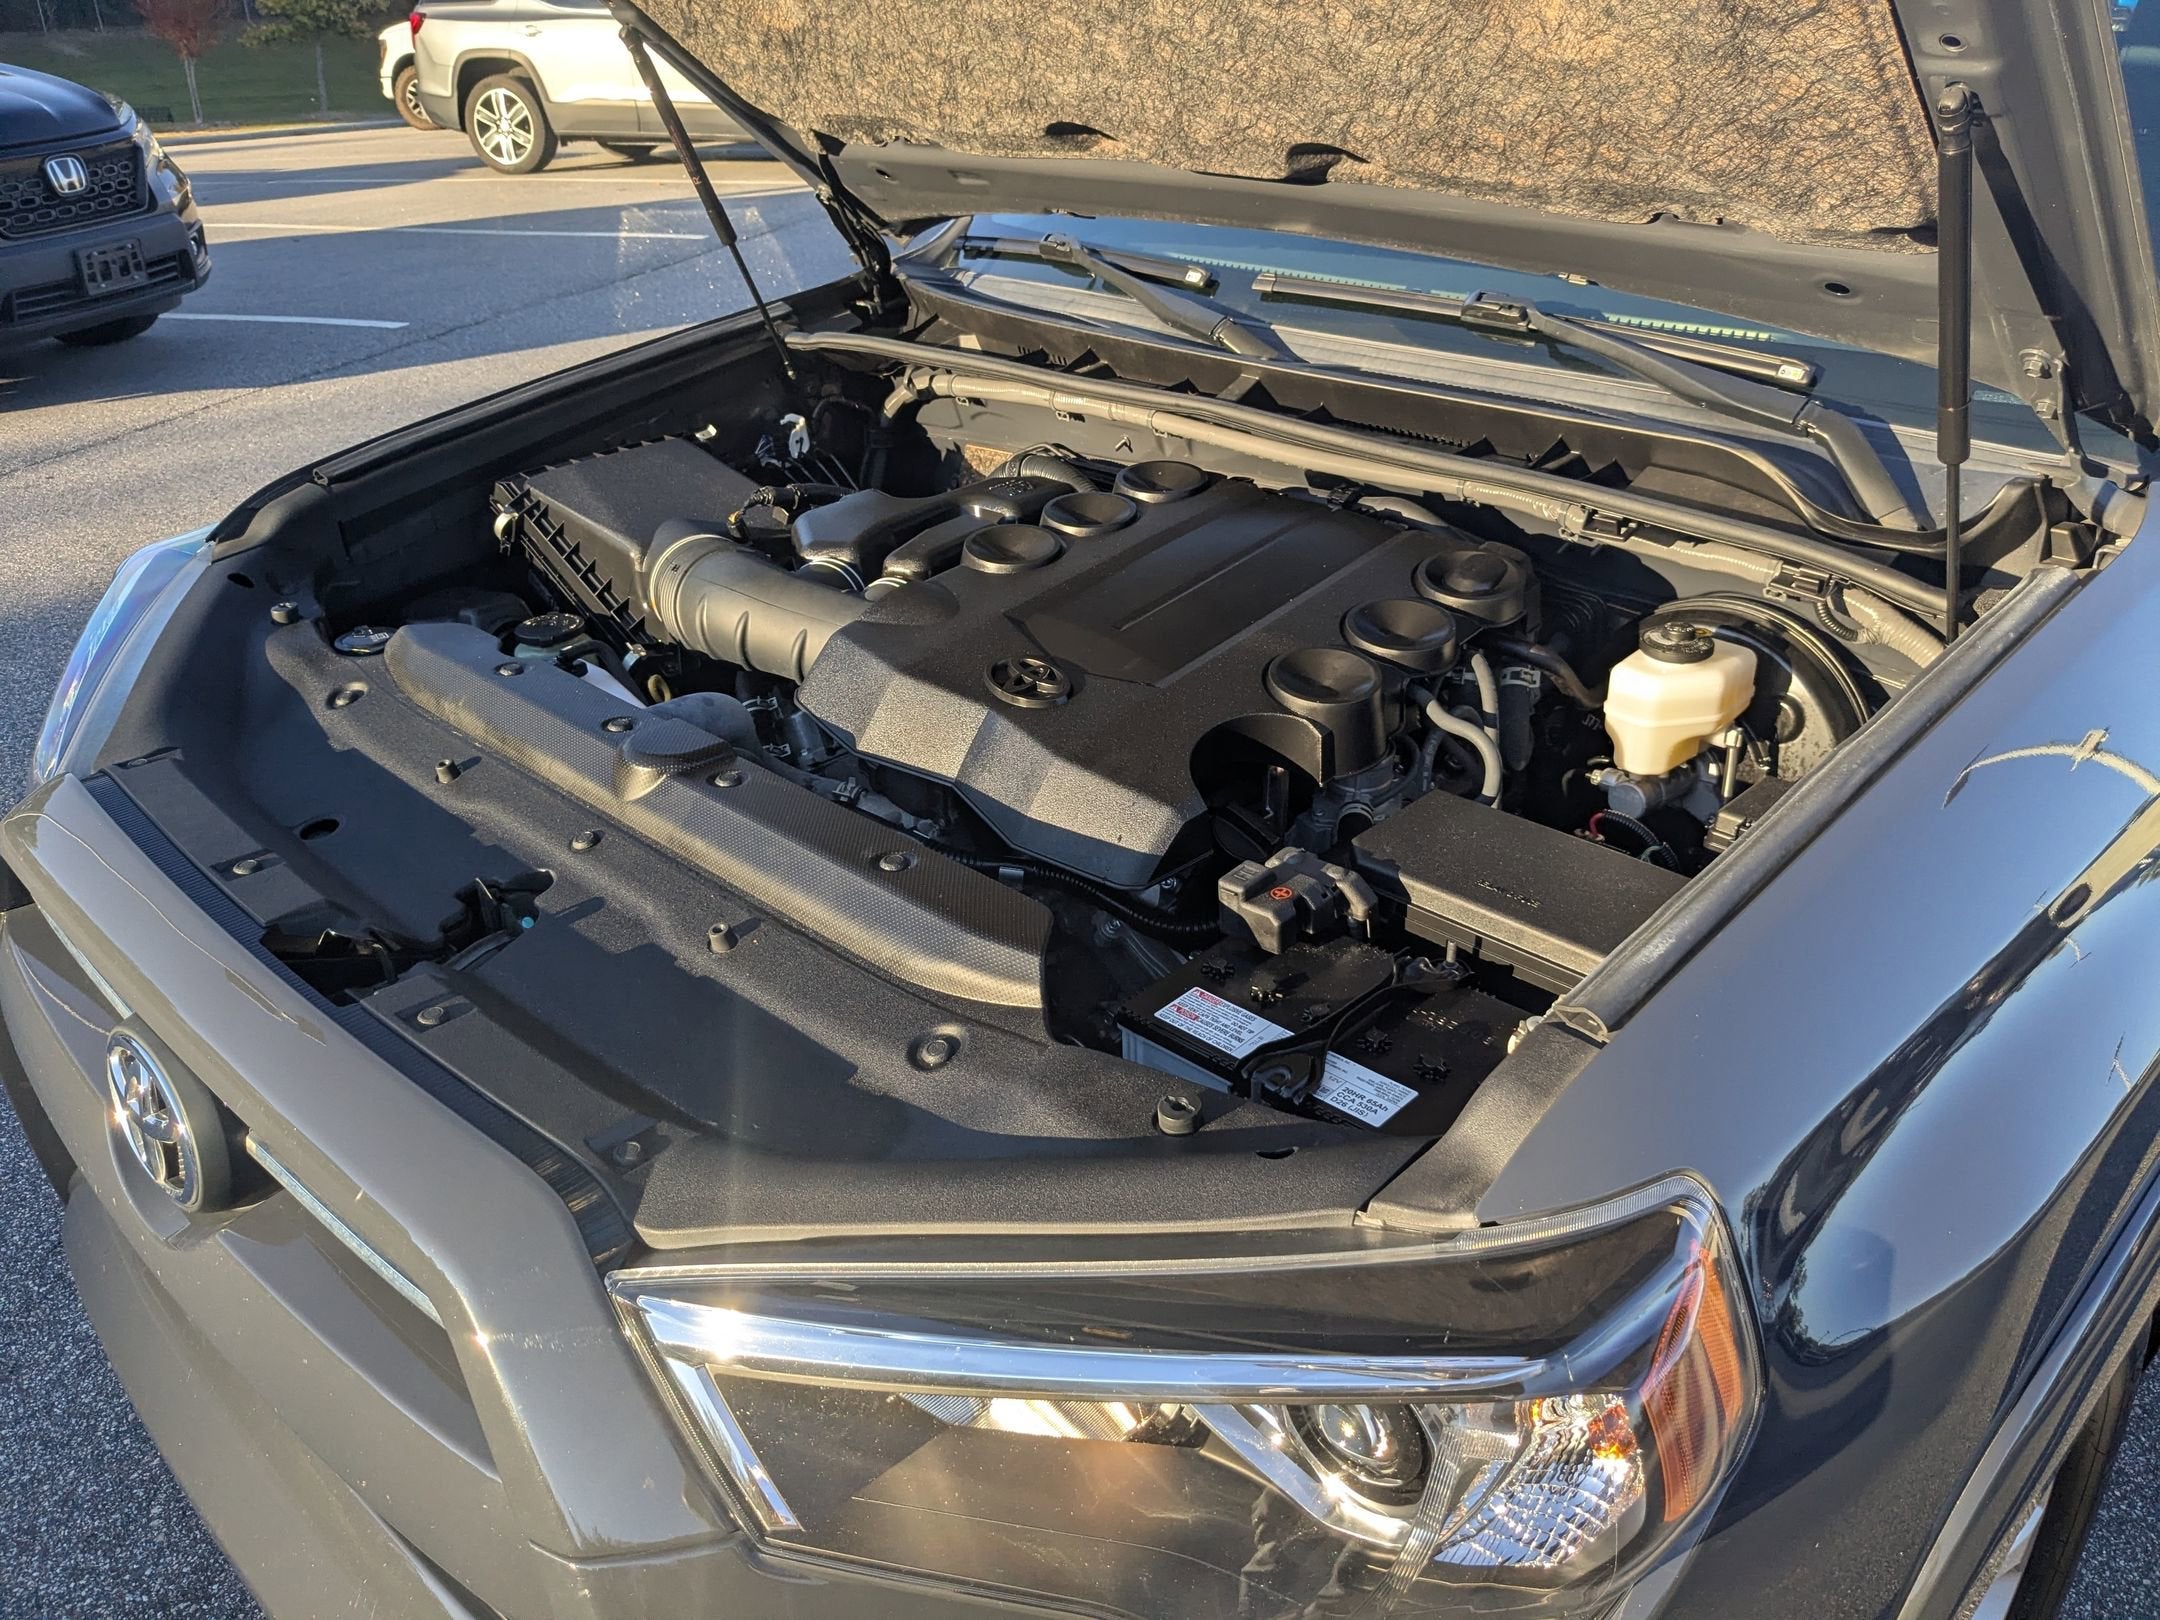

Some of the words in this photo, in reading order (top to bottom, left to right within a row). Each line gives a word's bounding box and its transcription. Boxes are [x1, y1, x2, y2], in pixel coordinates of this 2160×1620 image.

[1330, 1096, 1347, 1107] D26
[1348, 1104, 1369, 1117] (JIS)
[1336, 1091, 1355, 1104] CCA
[1358, 1101, 1378, 1114] 530A
[1342, 1086, 1366, 1101] 20HR
[1366, 1098, 1388, 1112] 65Ah
